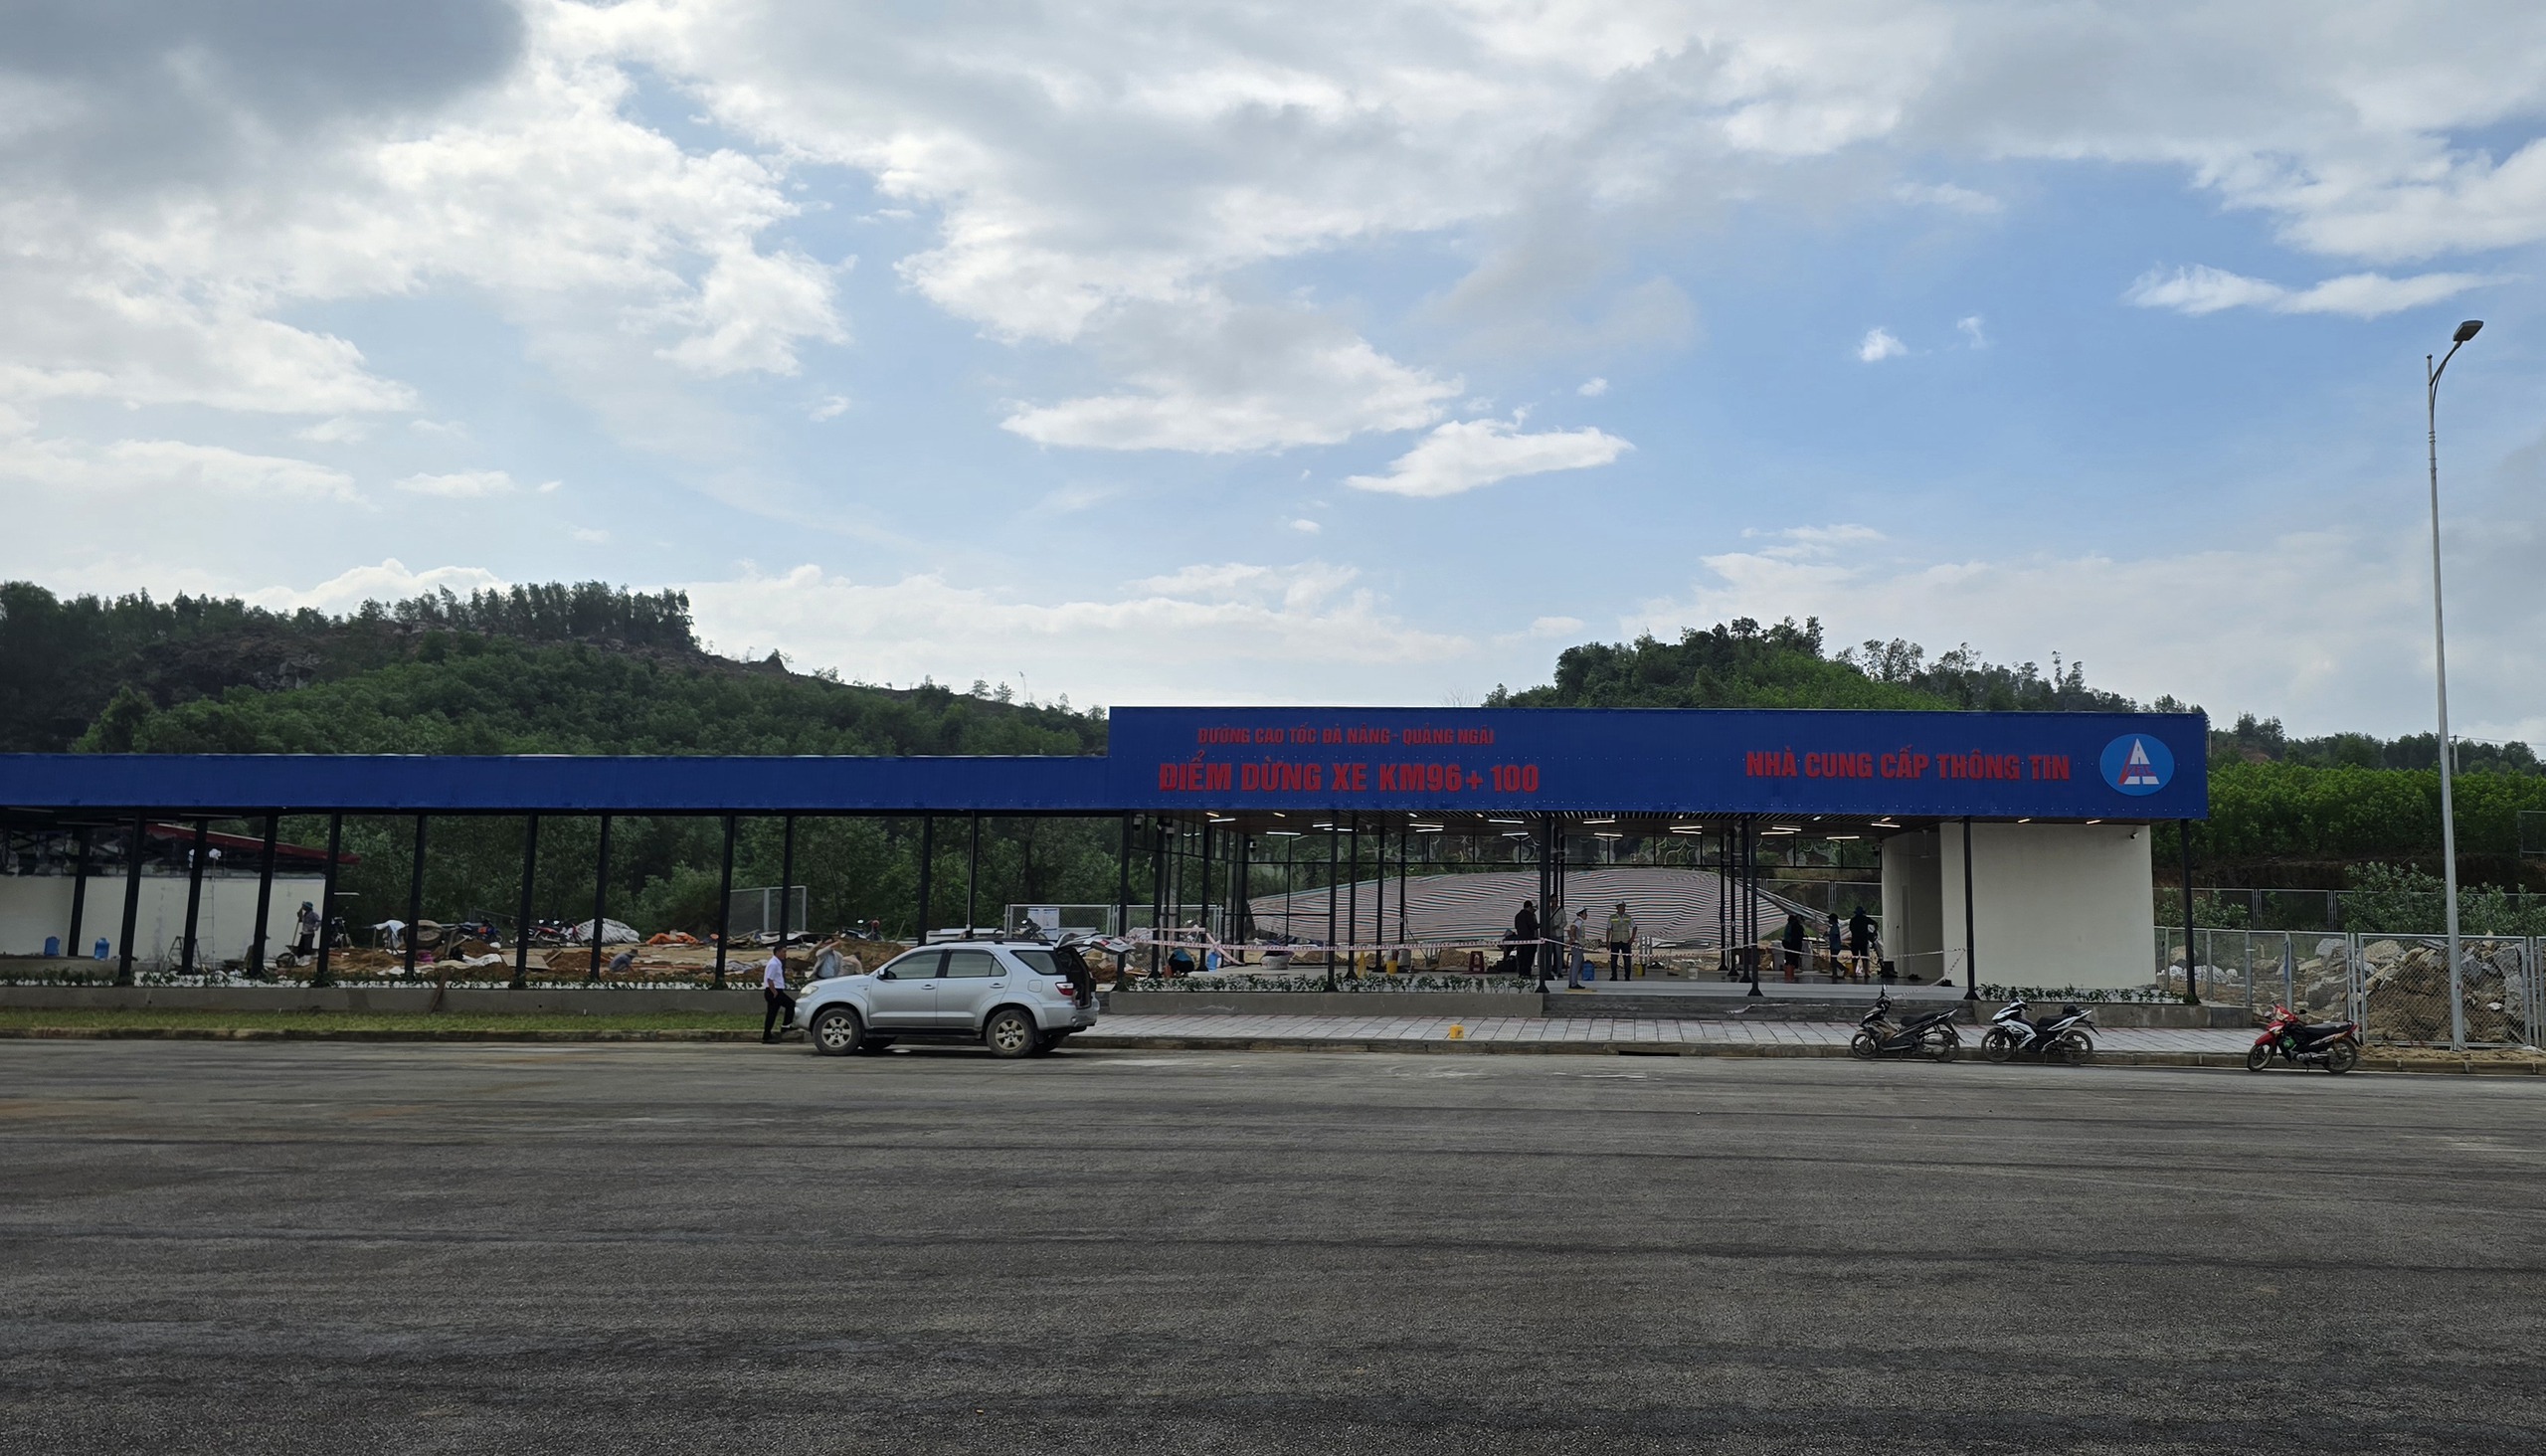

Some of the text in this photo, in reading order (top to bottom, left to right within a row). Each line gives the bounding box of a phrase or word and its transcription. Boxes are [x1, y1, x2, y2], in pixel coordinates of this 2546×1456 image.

[1255, 728, 1285, 744] CAO
[1290, 722, 1317, 744] TỐC
[1323, 724, 1343, 744] ĐÀ
[1403, 723, 1454, 745] QUẢNG
[1458, 724, 1495, 745] NGÃI
[1159, 750, 1232, 792] ĐIỂM
[1241, 756, 1322, 792] DỪNG
[1333, 764, 1367, 792] XE
[1745, 744, 2071, 781] NHÀ CUNG CẤP THÔNG TIN
